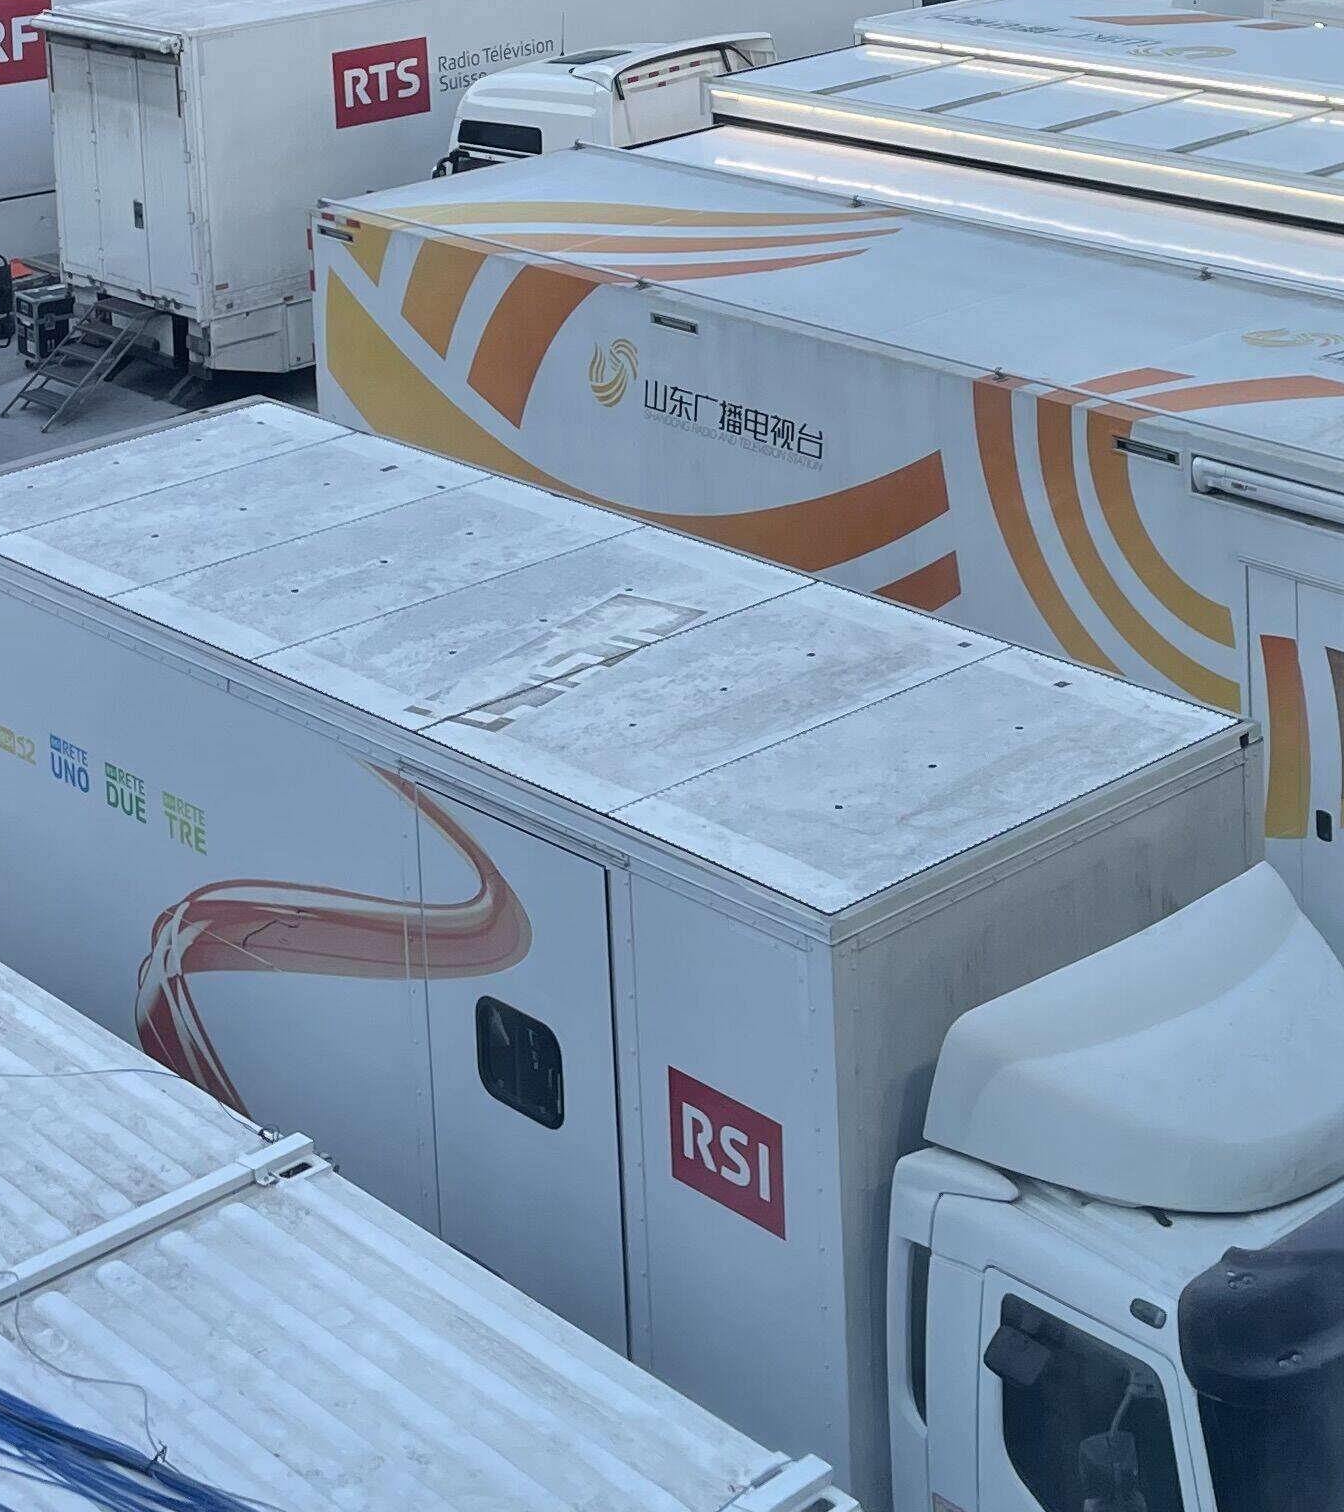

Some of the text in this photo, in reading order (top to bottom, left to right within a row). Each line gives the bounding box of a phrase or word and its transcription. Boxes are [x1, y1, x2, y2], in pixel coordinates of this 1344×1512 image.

[438, 39, 554, 72] Radio Télévision
[343, 57, 421, 108] RTS
[644, 379, 823, 459] 山东广播电视台
[51, 751, 90, 793] UNO
[62, 739, 89, 767] RETE
[106, 780, 147, 824] DUE
[118, 768, 146, 796] RETE
[164, 810, 208, 856] TRE
[176, 798, 206, 826] RETE
[681, 1101, 772, 1204] RSI
